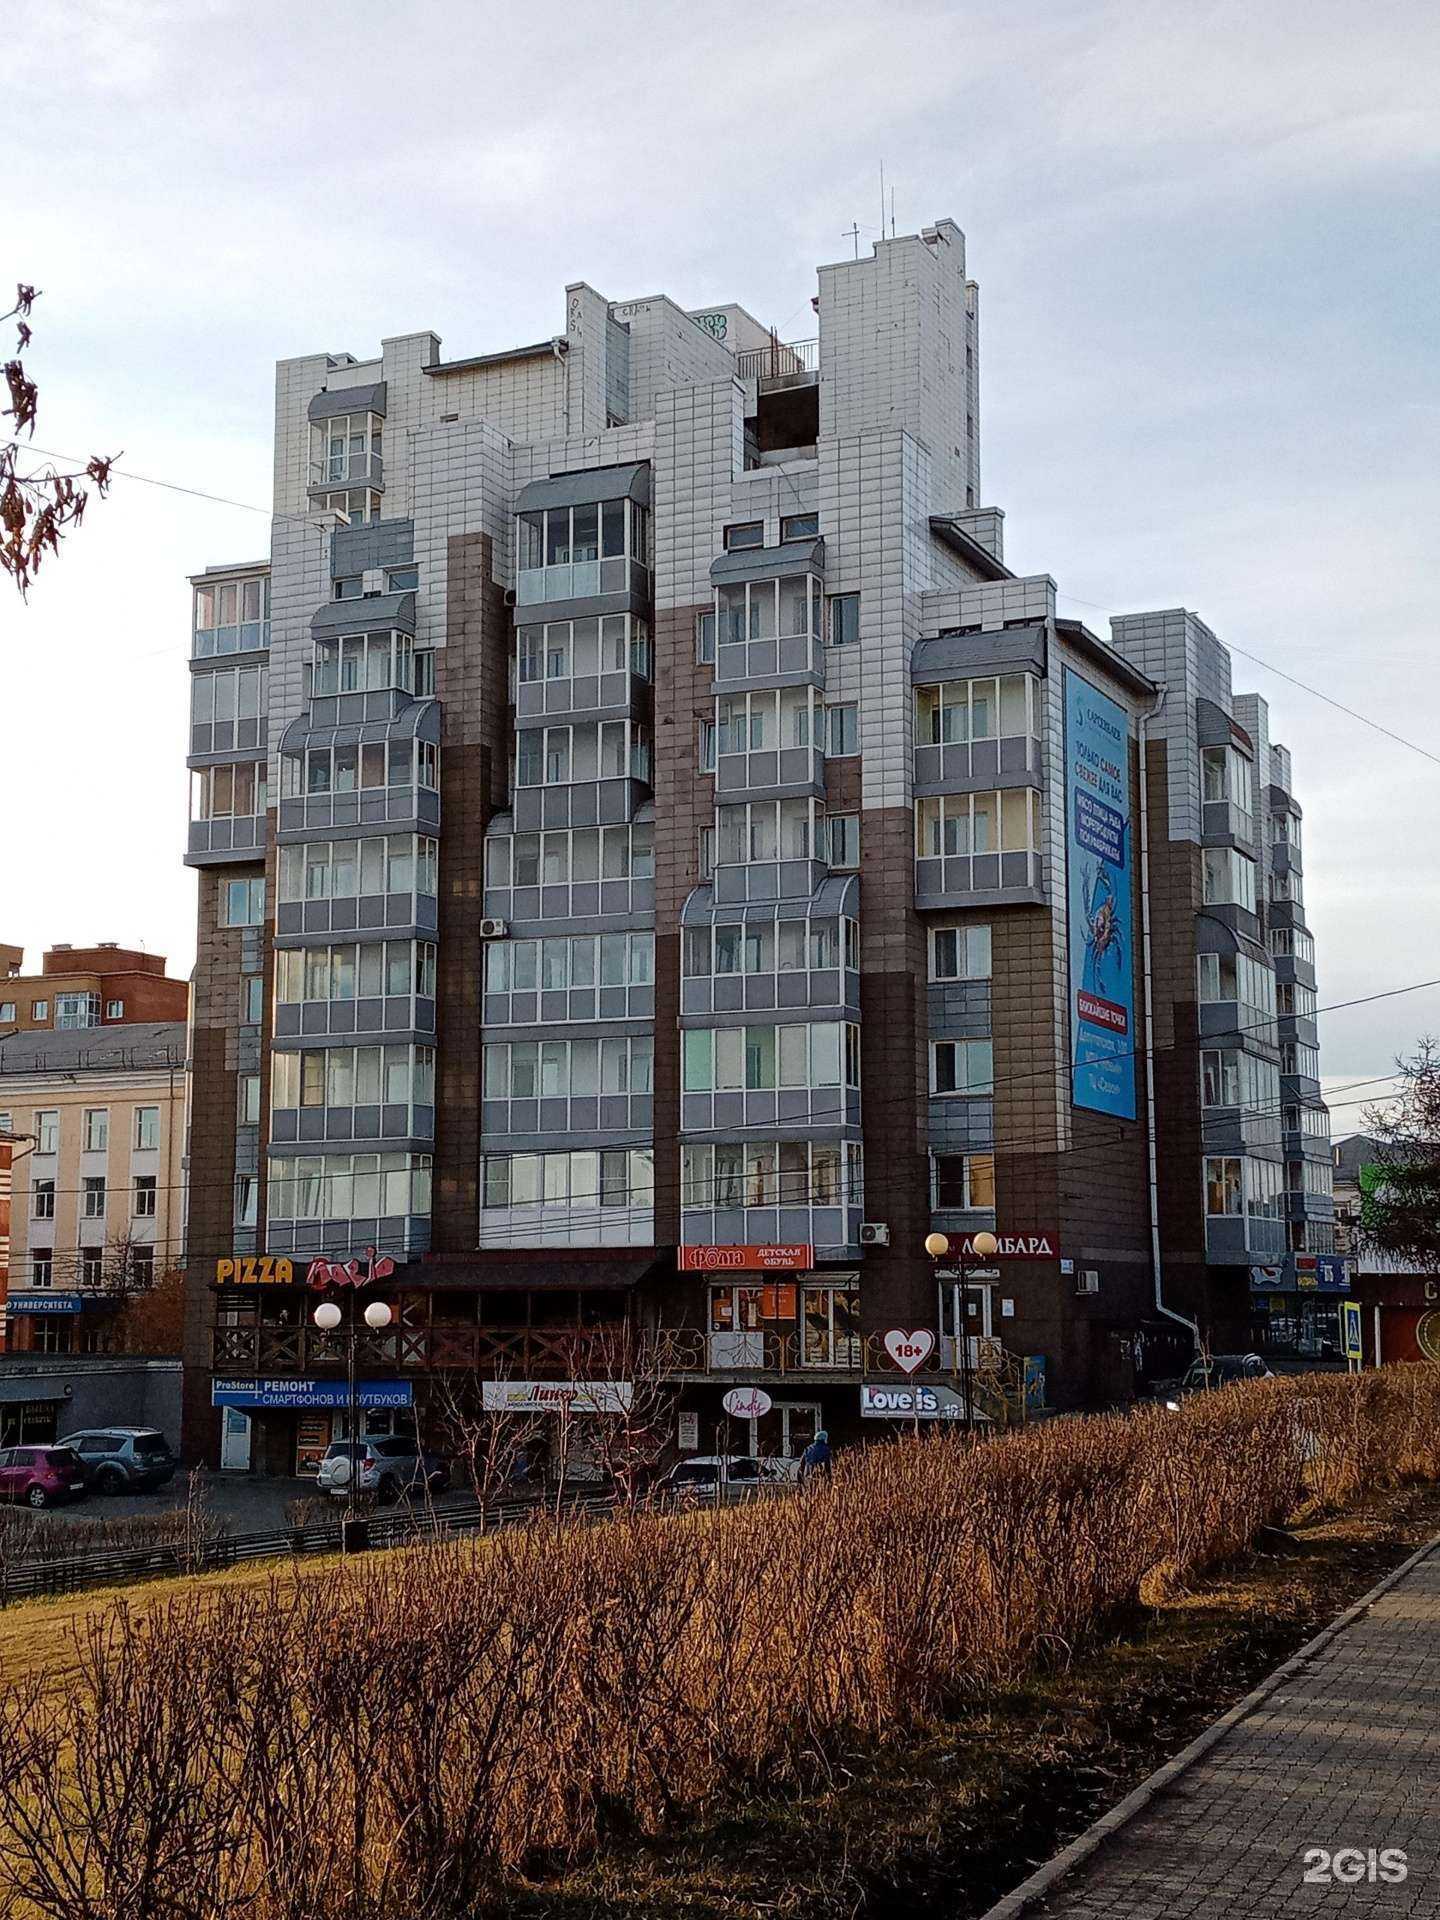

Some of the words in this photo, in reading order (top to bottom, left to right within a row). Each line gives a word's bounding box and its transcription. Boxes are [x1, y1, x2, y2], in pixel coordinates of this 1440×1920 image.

[962, 1237, 1053, 1255] ЛМБАРД
[217, 1257, 293, 1284] PIZZA
[895, 1344, 923, 1358] 18+
[216, 1380, 255, 1391] ProStore
[264, 1381, 315, 1392] РЕМОНТ
[262, 1394, 334, 1405] СМАРТФОНОВ
[336, 1394, 345, 1405] И
[727, 1386, 767, 1417] Cindy
[863, 1387, 912, 1409] Love
[916, 1387, 937, 1410] is
